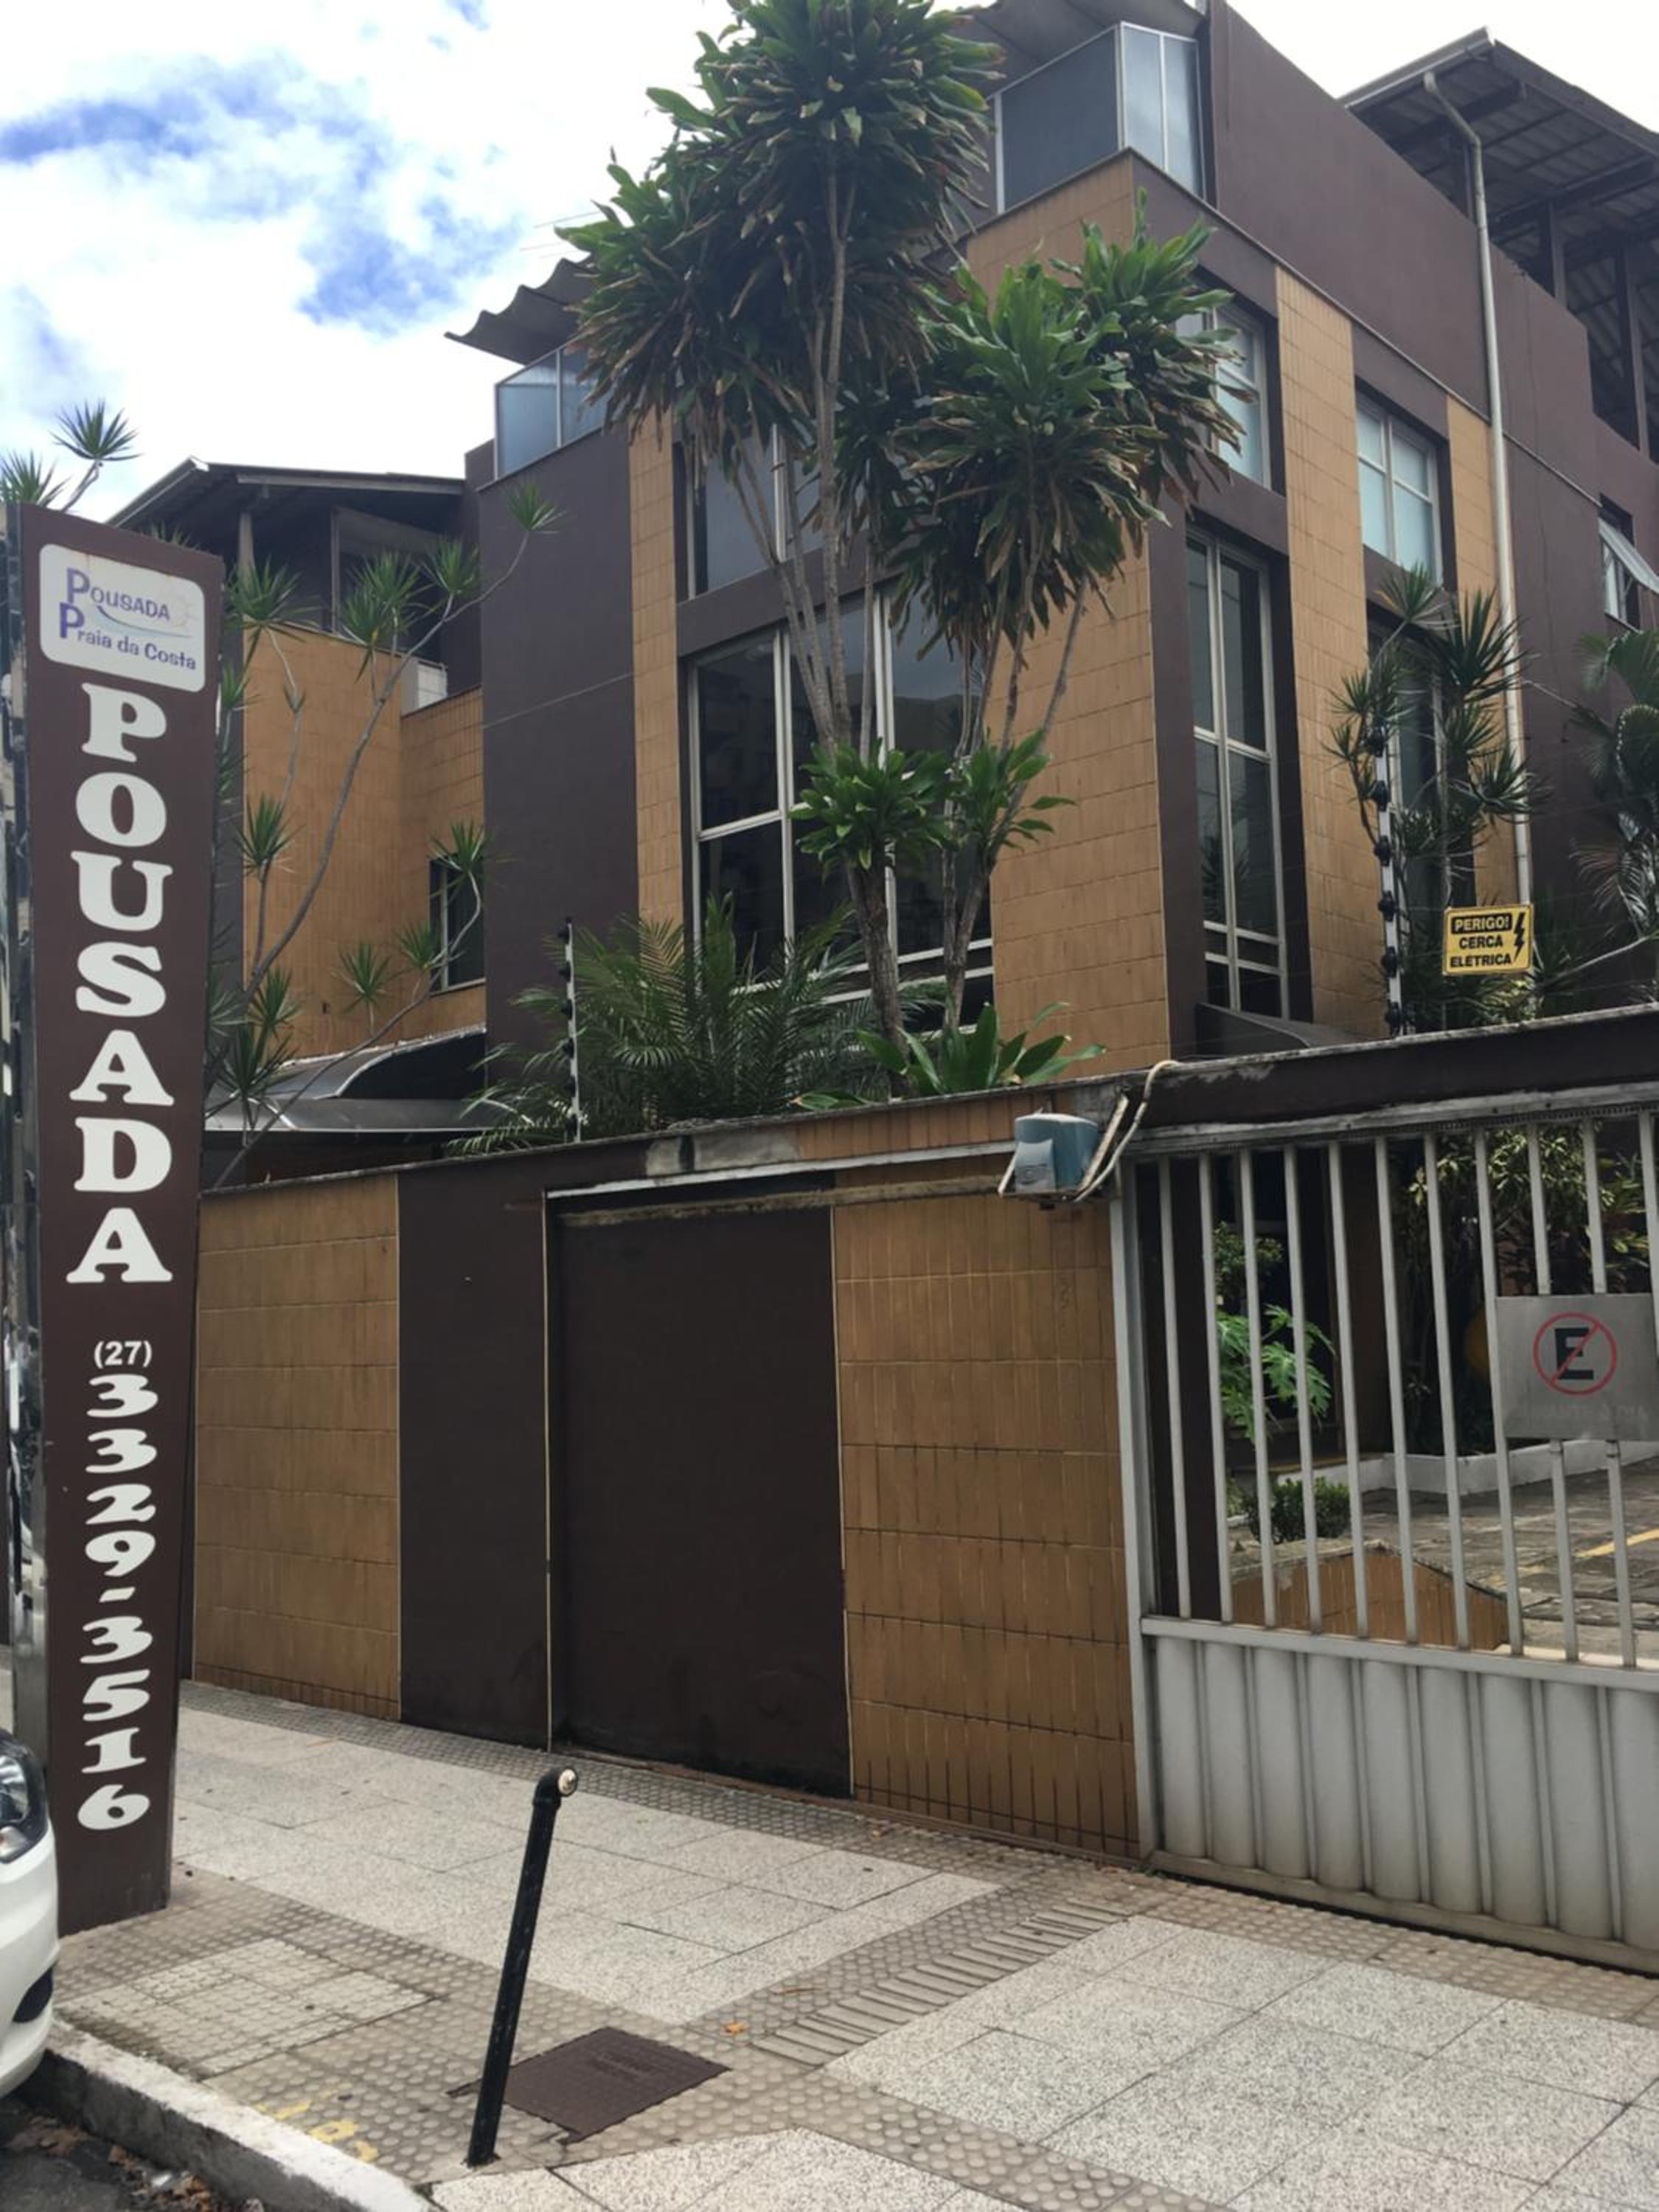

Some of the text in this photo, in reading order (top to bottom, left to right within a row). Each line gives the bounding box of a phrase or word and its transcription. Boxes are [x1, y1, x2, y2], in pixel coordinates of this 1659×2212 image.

[66, 566, 170, 622] POUSADA
[59, 601, 196, 670] Praia da Costa
[1454, 917, 1509, 932] PERIGO!
[1459, 935, 1503, 950] CERCA
[67, 683, 174, 1283] POUSADA
[94, 1340, 152, 1368] (27)
[1555, 1328, 1594, 1380] E
[78, 1374, 157, 1830] 3329-3516
